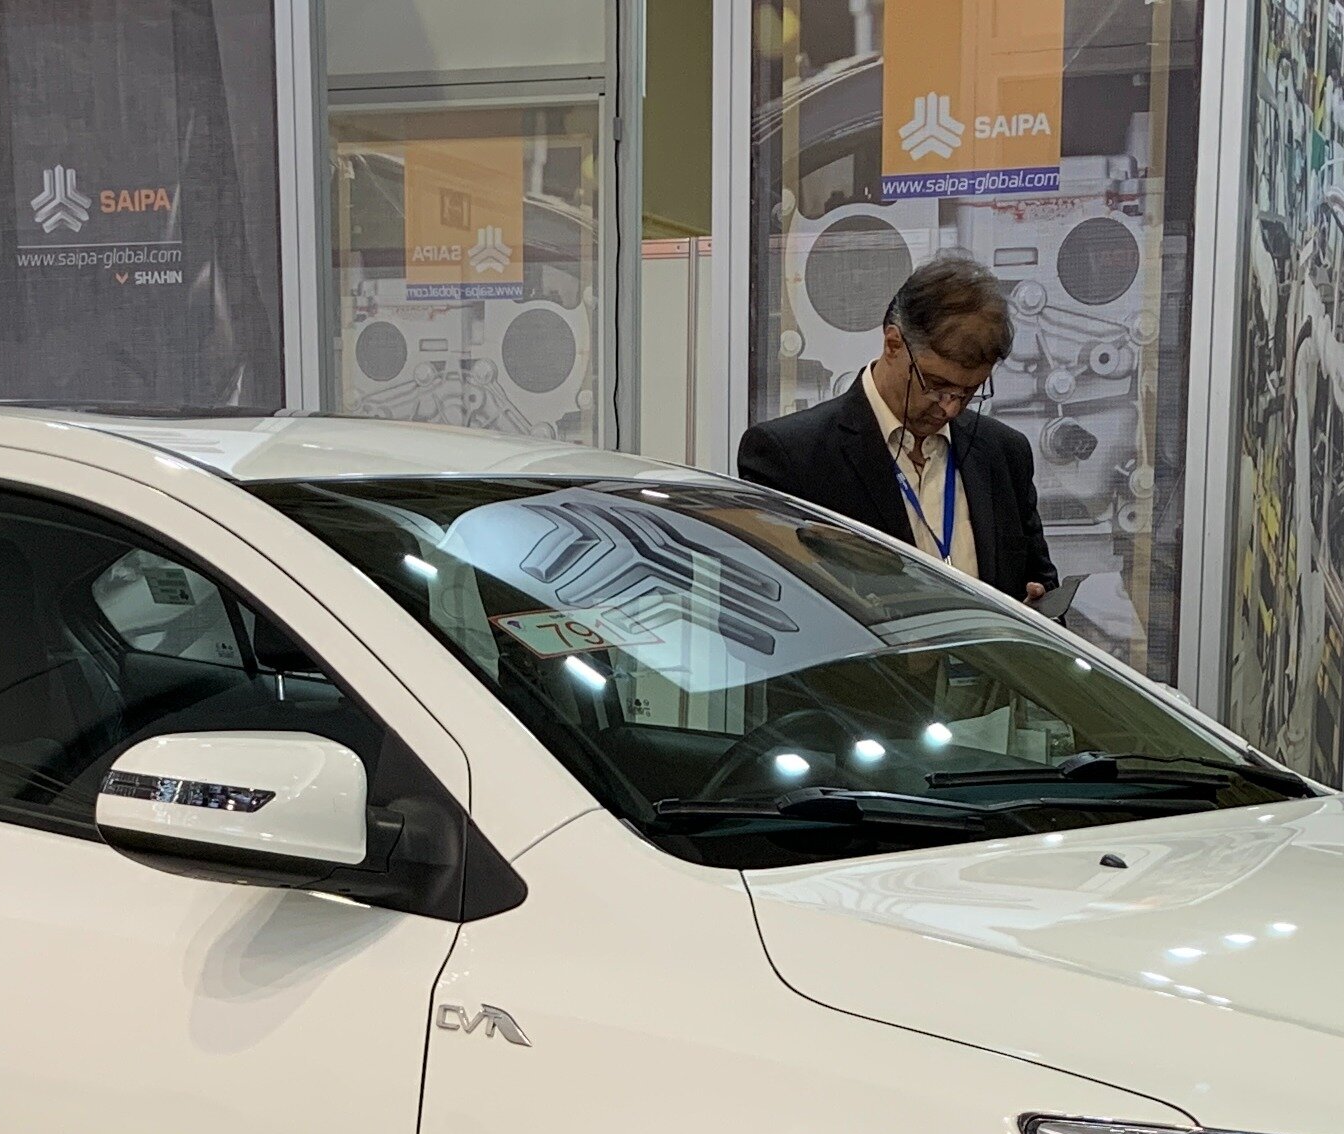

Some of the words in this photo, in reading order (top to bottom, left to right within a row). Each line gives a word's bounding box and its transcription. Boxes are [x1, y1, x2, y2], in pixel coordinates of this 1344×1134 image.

[974, 112, 1052, 139] SAIPA
[882, 170, 1060, 195] www.saipa-global.com
[99, 188, 172, 214] SAIPA
[17, 248, 182, 269] www.saipa-global.com
[134, 271, 183, 285] SHAHIN
